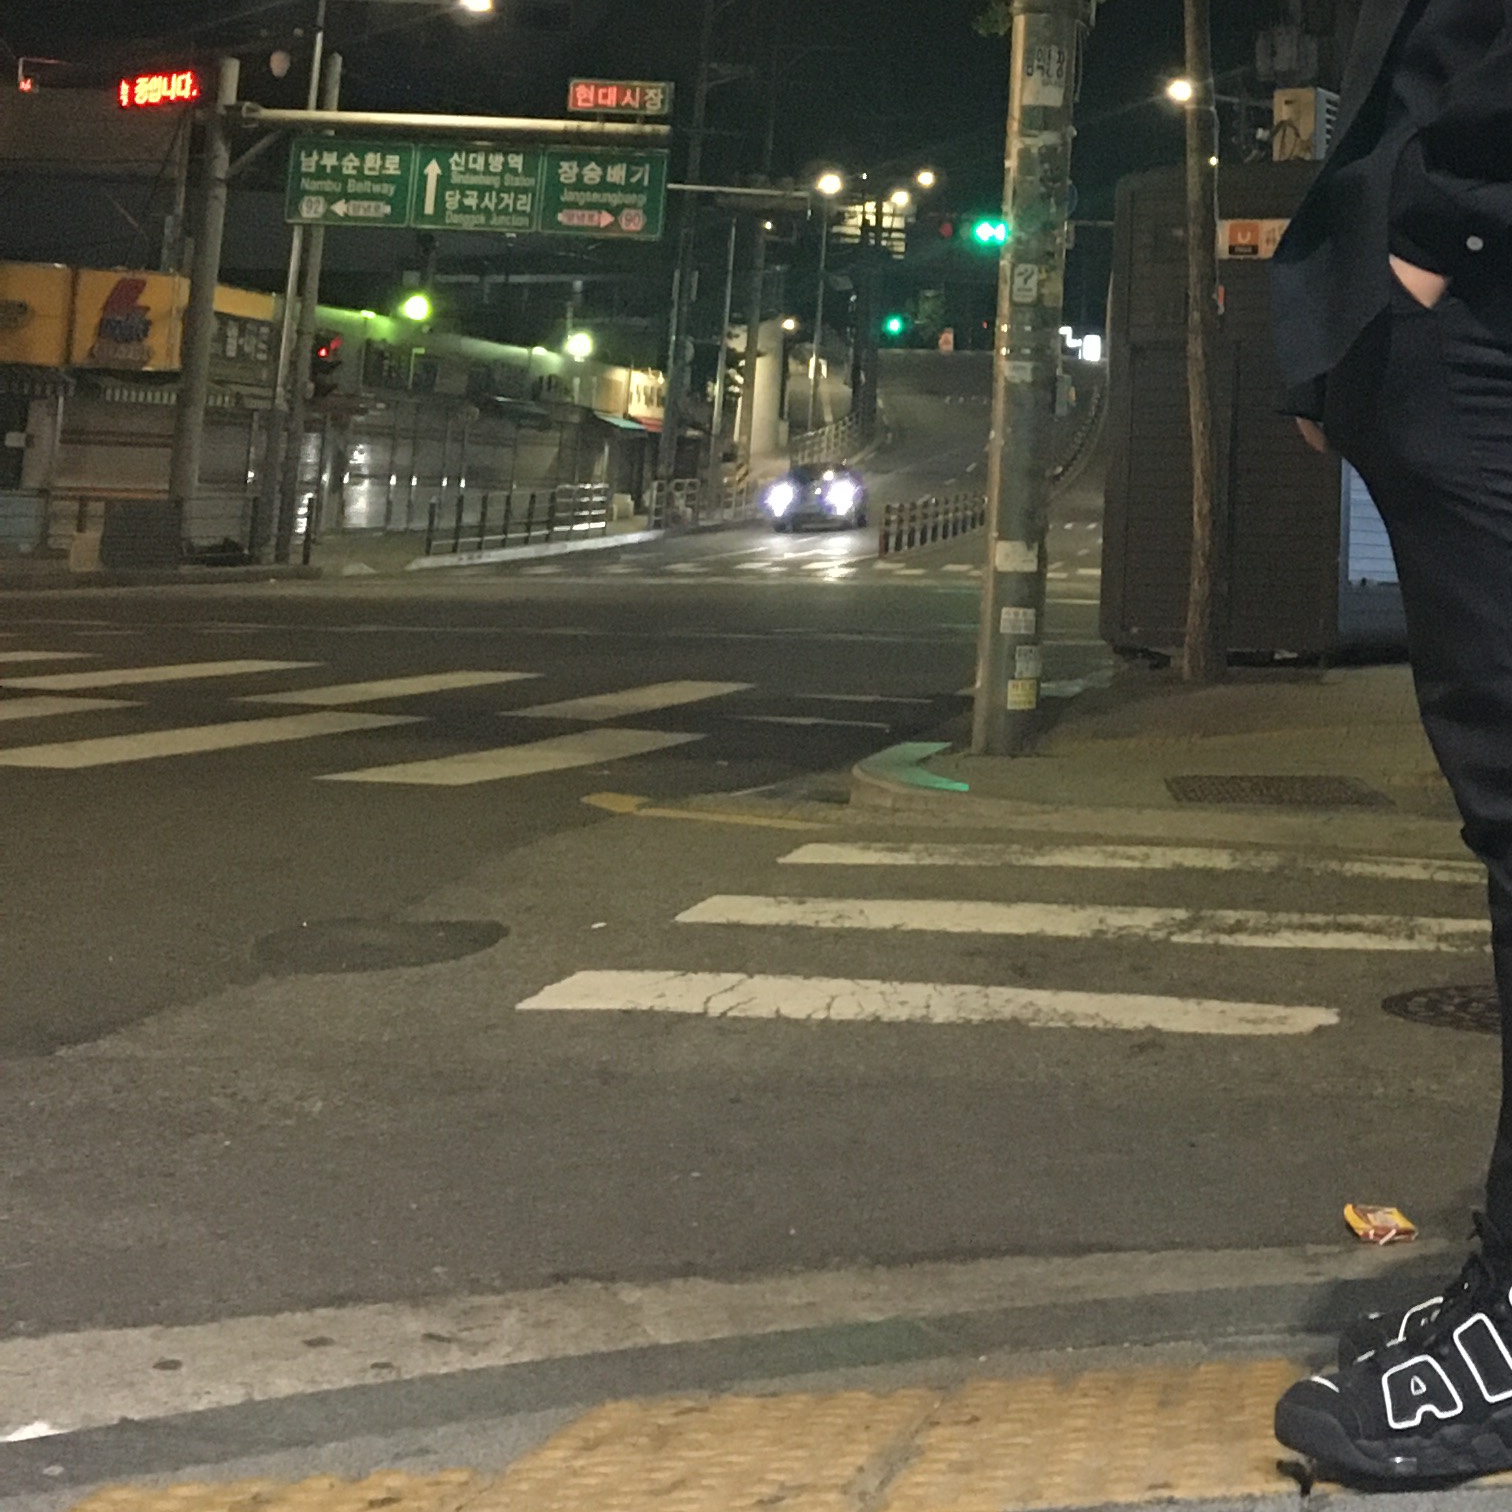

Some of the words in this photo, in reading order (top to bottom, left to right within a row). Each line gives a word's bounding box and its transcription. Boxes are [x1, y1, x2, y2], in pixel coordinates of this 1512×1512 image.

[575, 84, 664, 112] 현대시장
[300, 149, 402, 176] 남부순환로
[448, 151, 524, 174] 신대방역
[558, 160, 650, 186] 장승배기
[445, 190, 532, 213] 당곡사거리
